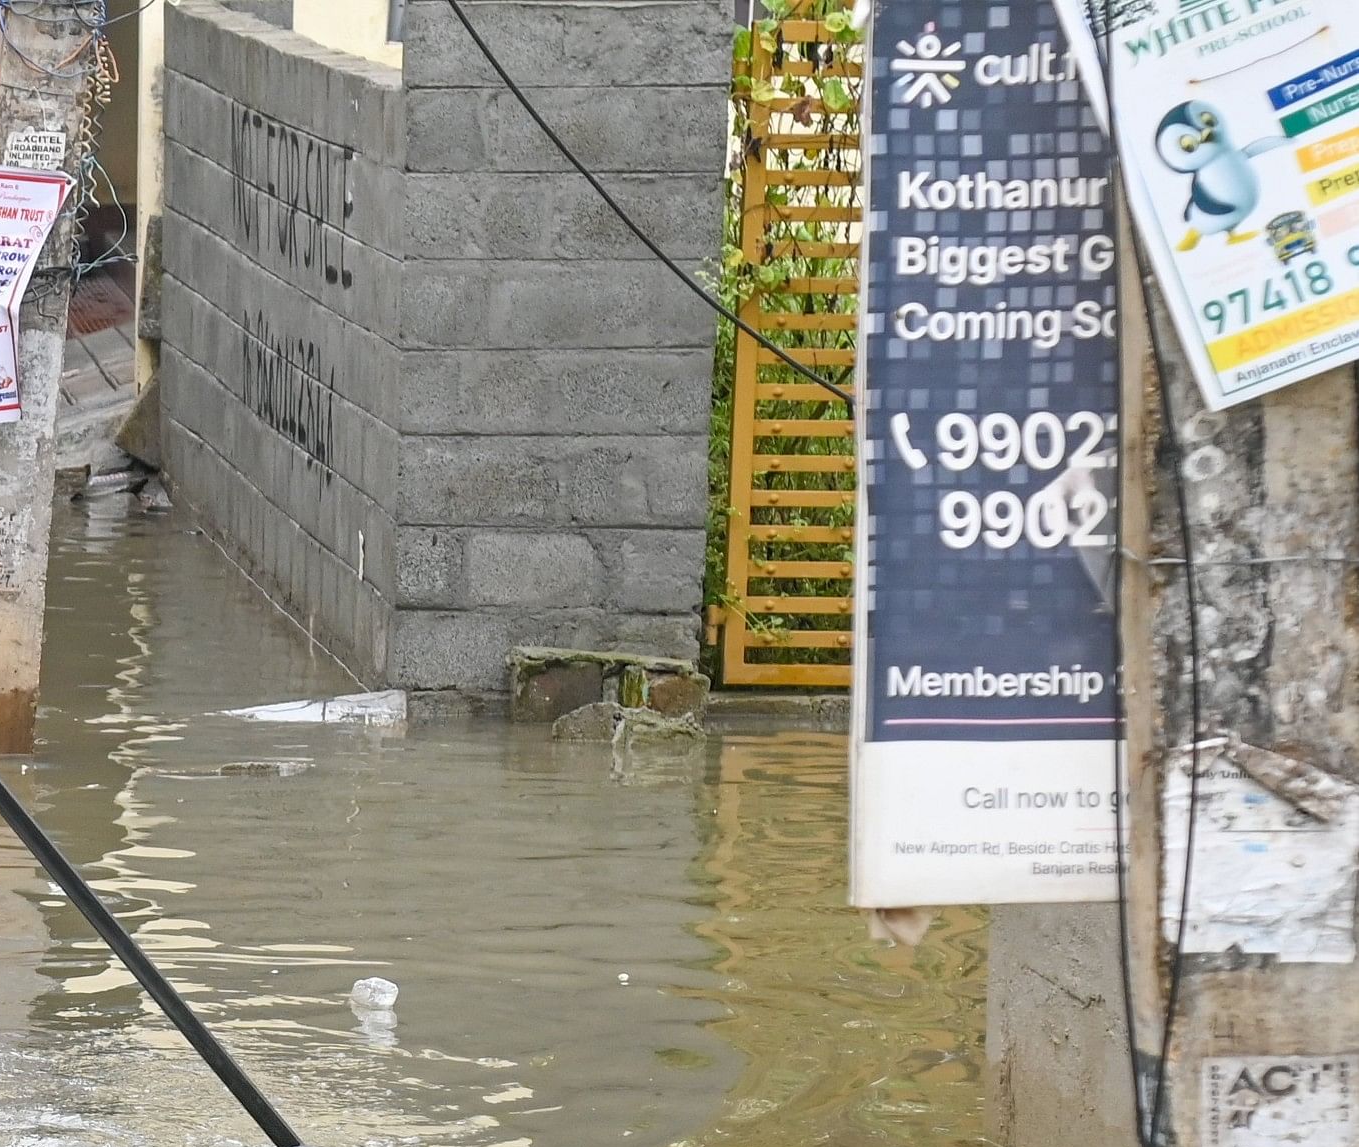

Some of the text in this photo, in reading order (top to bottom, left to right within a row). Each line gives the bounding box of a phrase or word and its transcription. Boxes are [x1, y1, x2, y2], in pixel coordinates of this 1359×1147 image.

[1197, 5, 1310, 56] PRE-SCHOOL
[231, 101, 354, 290] NOT FOR SALE
[897, 171, 1109, 210] Kothanur
[897, 235, 1070, 285] Biggest
[1203, 261, 1333, 335] 97418
[896, 301, 1061, 349] Coming
[939, 490, 1118, 549] 9902
[887, 664, 1104, 703] Membership
[963, 787, 1008, 809] Call
[1017, 792, 1068, 809] now
[1076, 788, 1101, 808] to
[895, 842, 924, 855] New
[931, 841, 977, 857] Airport
[1009, 842, 1055, 855] Beside
[1033, 862, 1084, 876] Banjara
